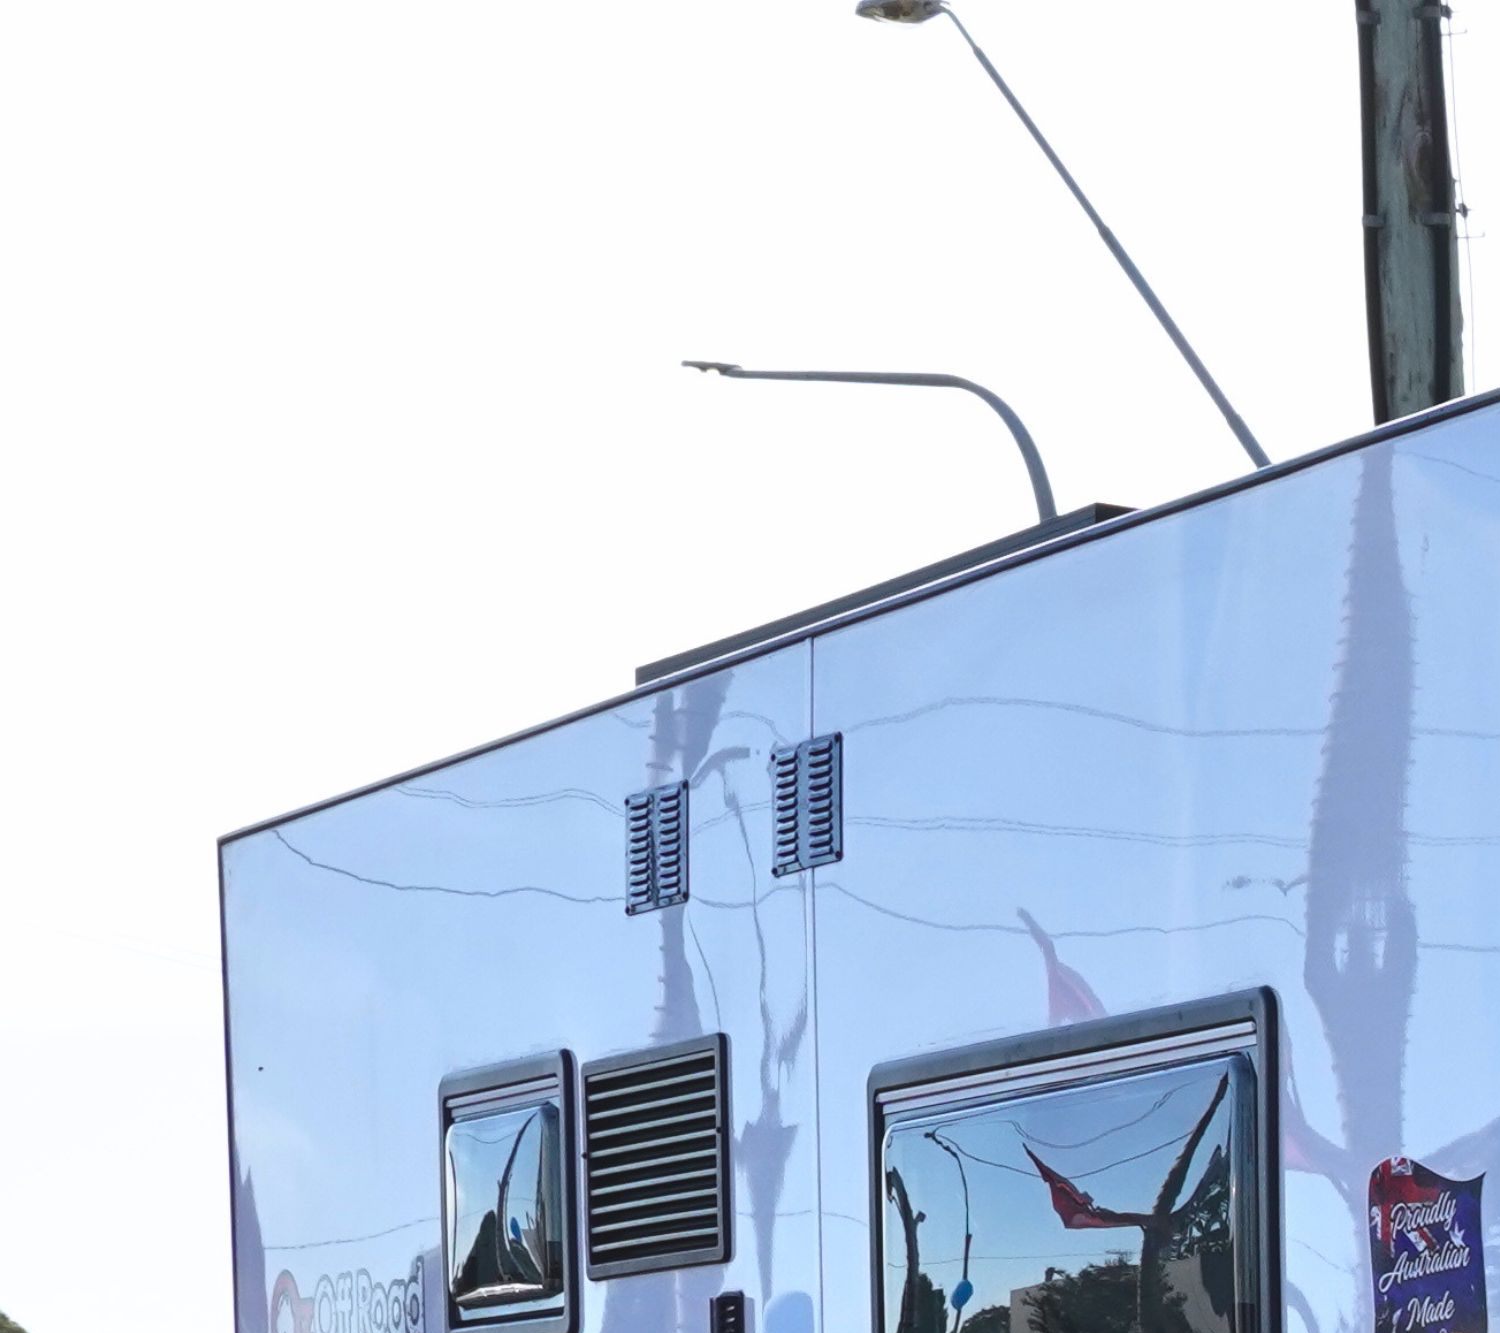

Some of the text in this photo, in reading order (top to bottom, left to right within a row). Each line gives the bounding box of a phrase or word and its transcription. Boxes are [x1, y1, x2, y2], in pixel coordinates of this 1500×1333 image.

[1391, 1191, 1456, 1238] Proudly
[1379, 1240, 1470, 1293] Australian
[1406, 1291, 1455, 1331] Made
